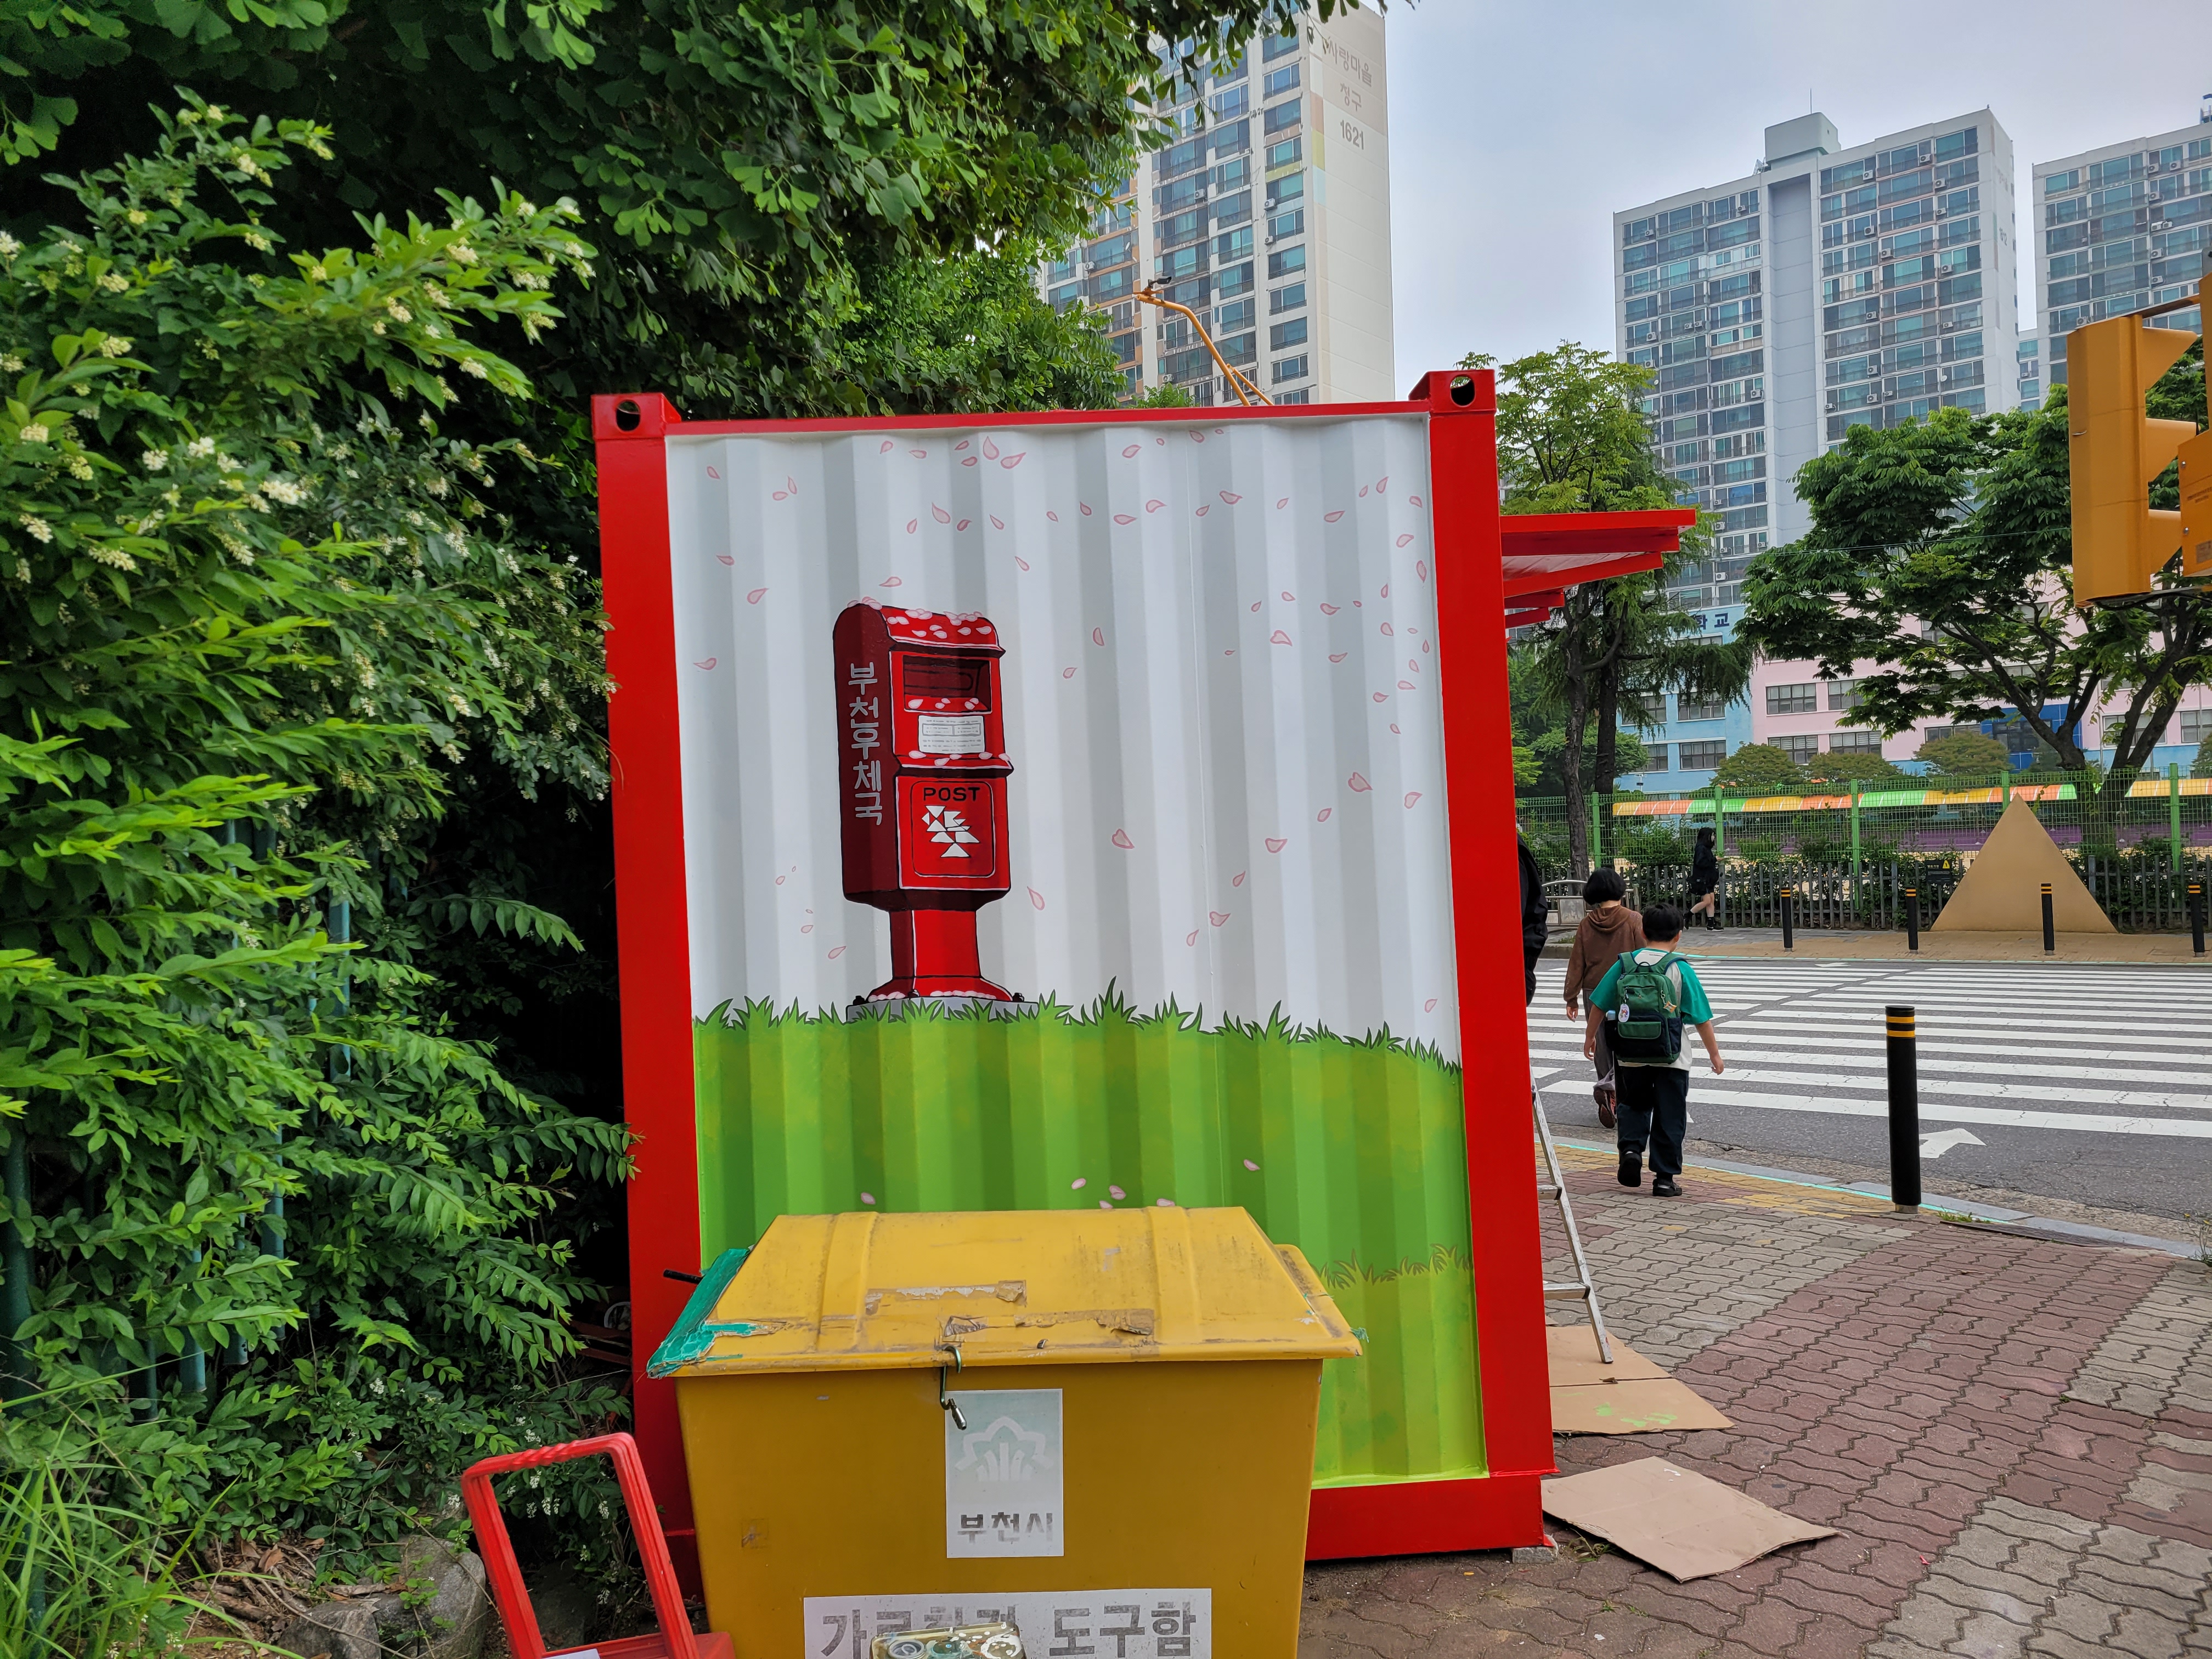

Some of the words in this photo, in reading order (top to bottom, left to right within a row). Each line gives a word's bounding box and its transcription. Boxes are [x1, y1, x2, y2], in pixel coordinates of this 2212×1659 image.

[1340, 83, 1362, 112] 청구
[1340, 120, 1364, 150] 1621
[848, 662, 882, 825] 부천우체국
[923, 787, 980, 802] POST
[957, 1512, 1053, 1544] 부천시
[1049, 1601, 1197, 1658] 도구함
